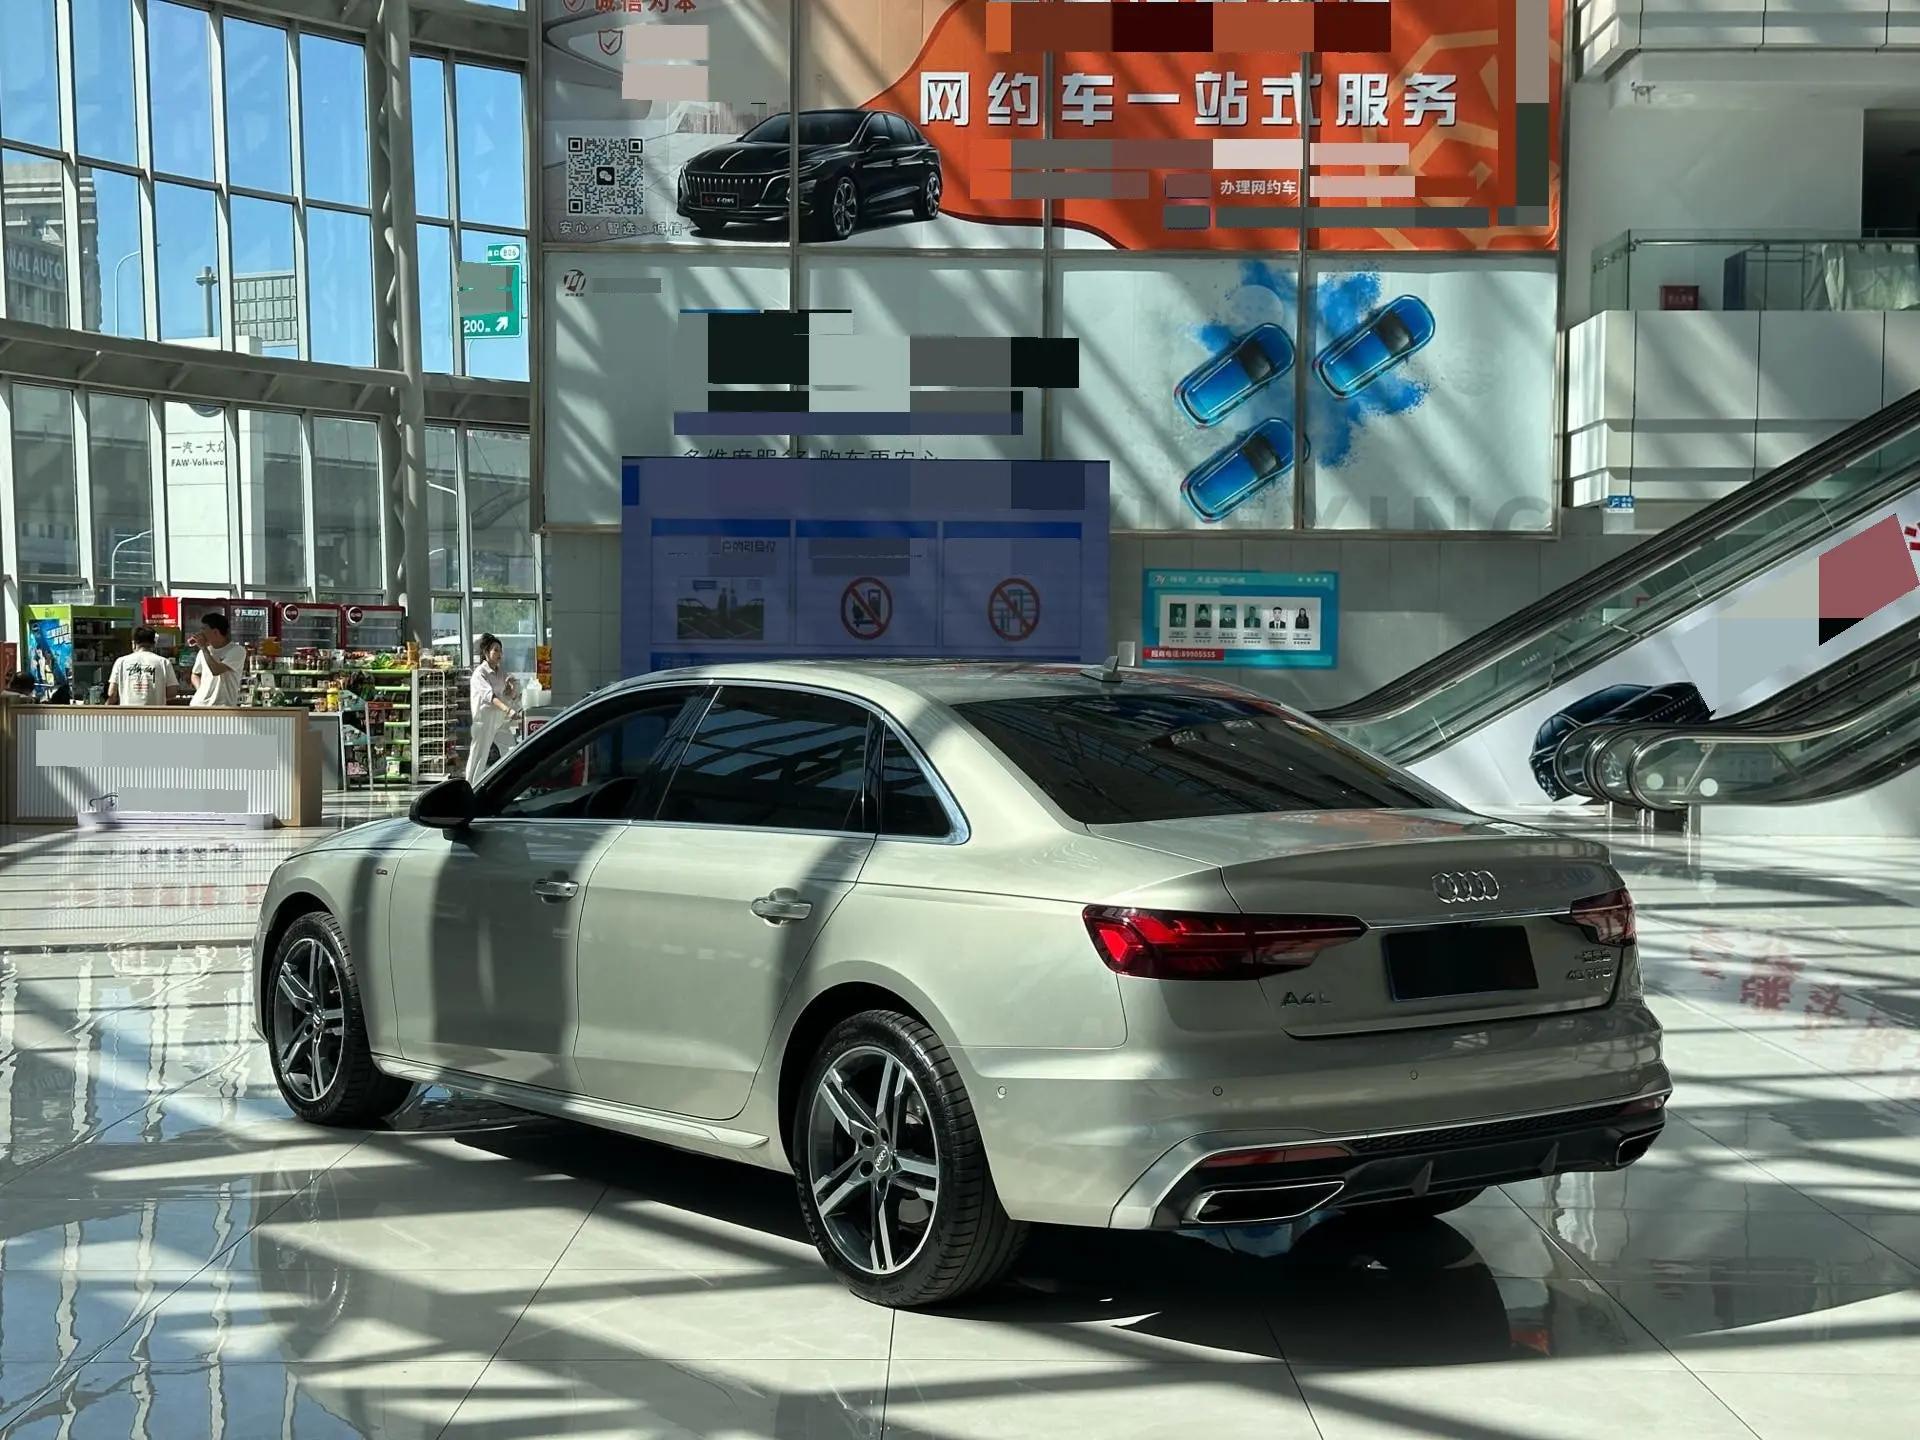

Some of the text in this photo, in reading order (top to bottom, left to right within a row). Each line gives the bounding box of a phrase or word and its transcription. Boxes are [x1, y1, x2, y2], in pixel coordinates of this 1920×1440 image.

[919, 72, 1457, 127] 网约车一站式服务
[1220, 180, 1297, 195] 办理网约车
[33, 255, 64, 281] AUTO
[1280, 991, 1334, 1008] A4L
